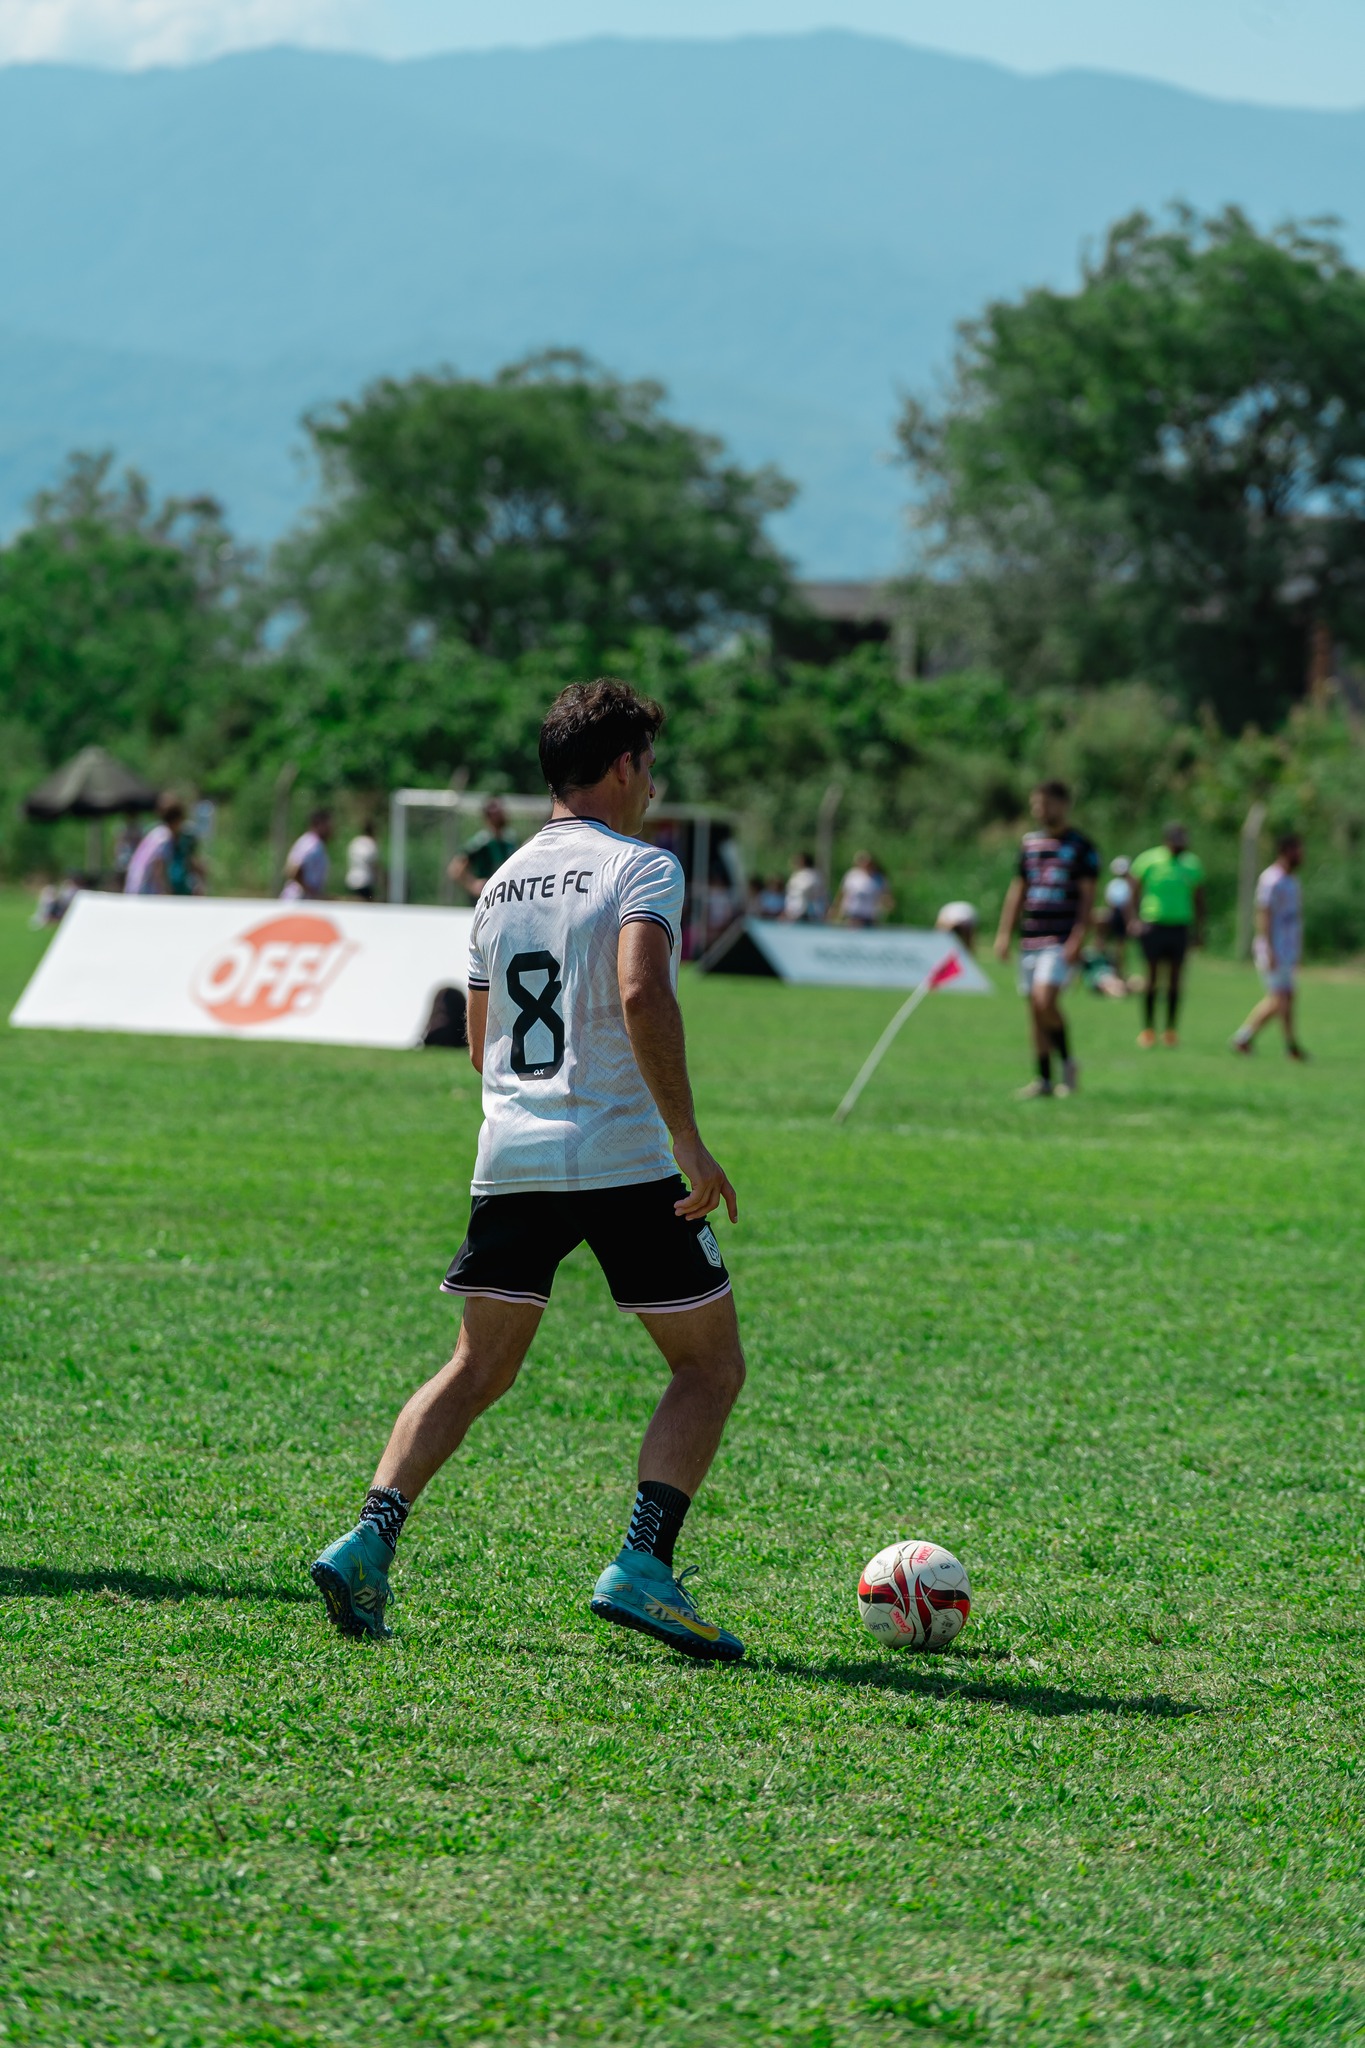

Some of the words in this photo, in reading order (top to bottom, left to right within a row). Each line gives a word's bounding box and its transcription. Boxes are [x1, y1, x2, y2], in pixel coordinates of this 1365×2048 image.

[562, 870, 594, 895] FC
[193, 940, 348, 1010] OFF!
[506, 949, 565, 1082] 8
